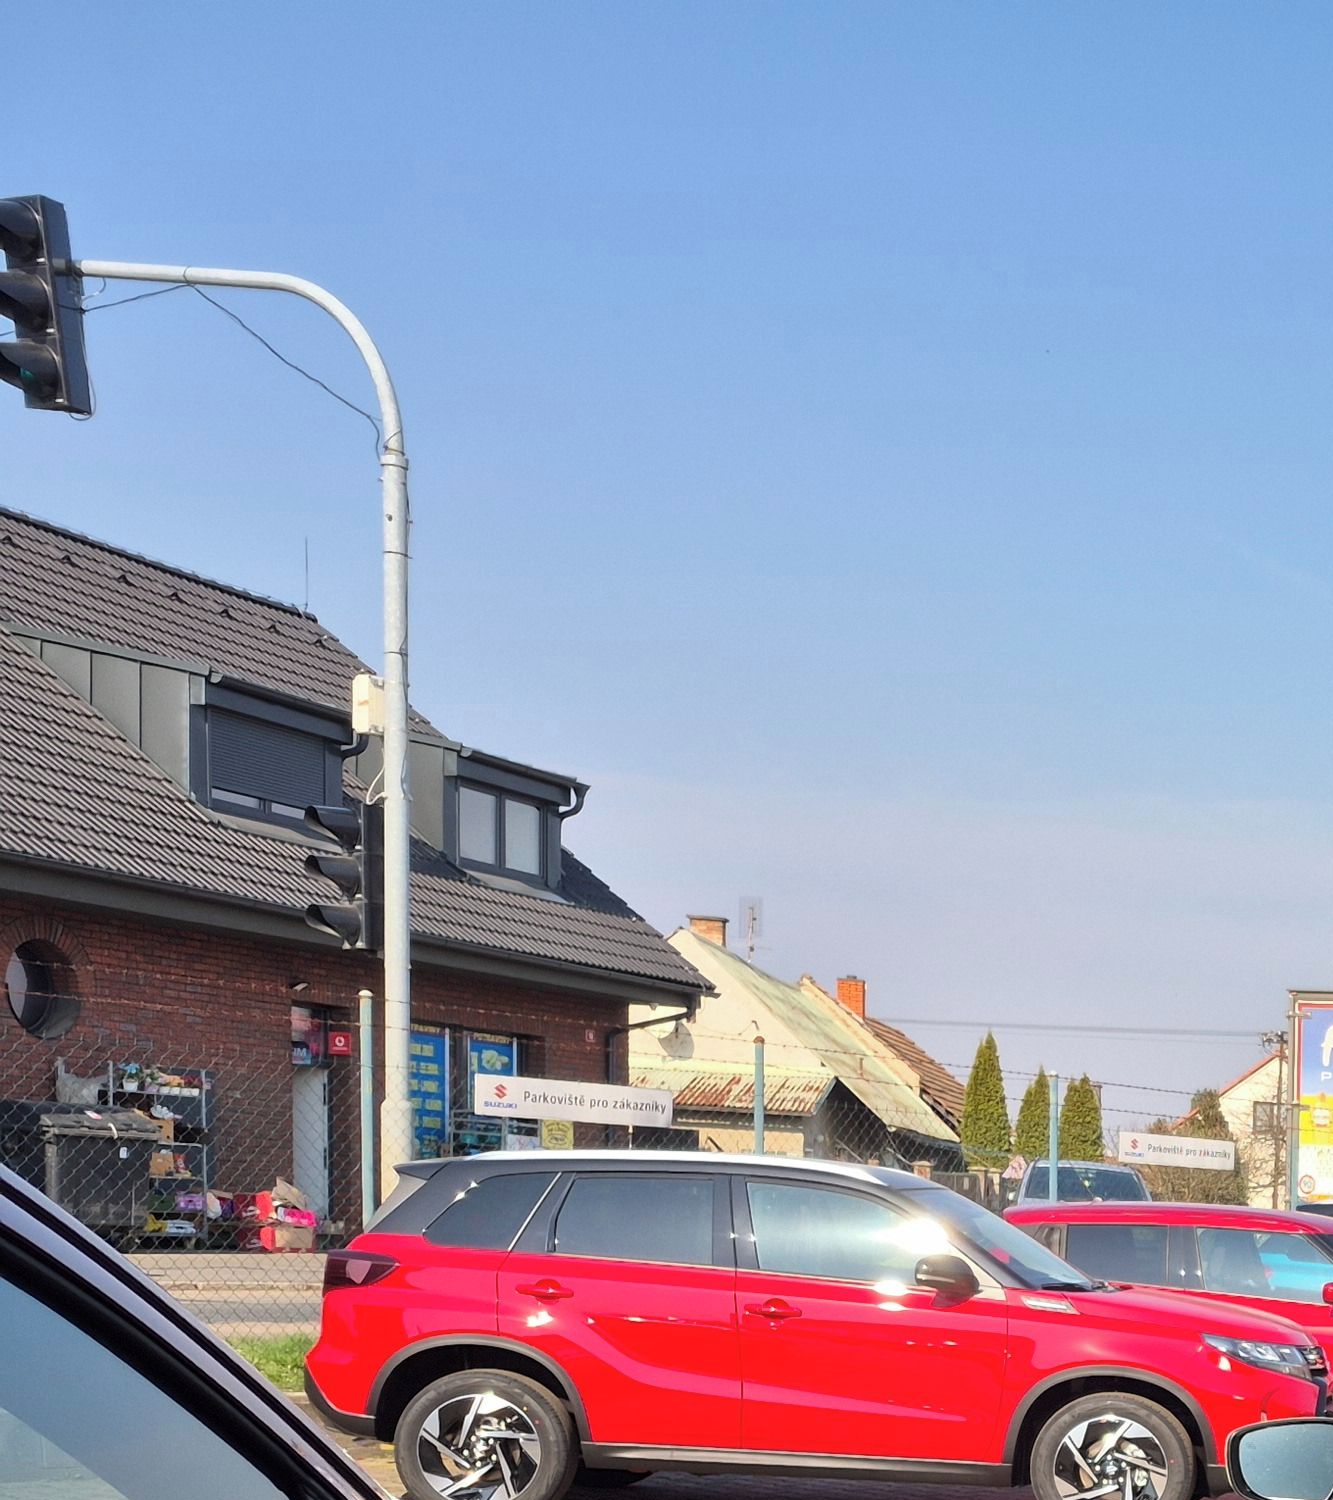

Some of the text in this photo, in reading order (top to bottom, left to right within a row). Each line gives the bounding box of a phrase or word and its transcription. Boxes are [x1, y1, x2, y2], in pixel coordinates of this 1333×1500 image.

[483, 1100, 518, 1109] SUZUKI
[523, 1090, 667, 1115] Parkoviště pro zákazníky
[1147, 1143, 1231, 1160] Parkoviště pro zákazníky
